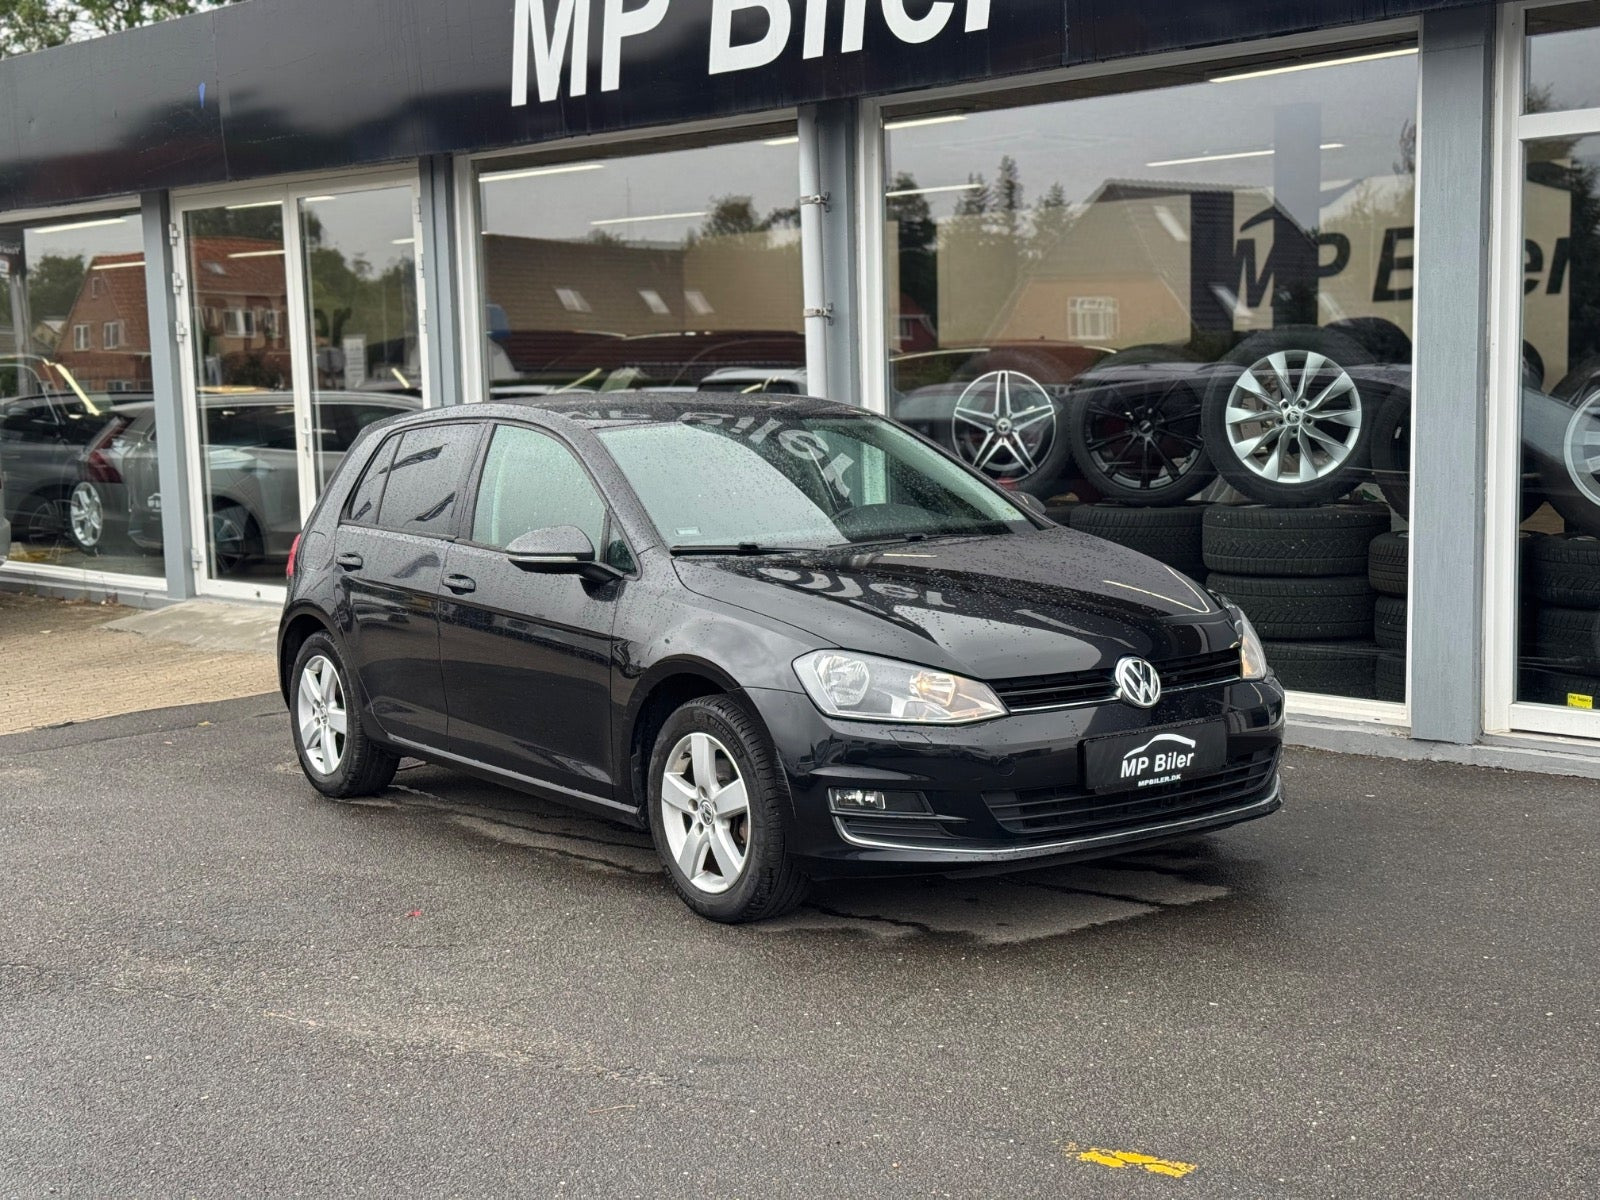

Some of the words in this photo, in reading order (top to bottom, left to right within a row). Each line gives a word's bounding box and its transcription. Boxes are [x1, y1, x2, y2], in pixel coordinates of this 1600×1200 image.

[511, 0, 669, 106] MP
[1120, 757, 1149, 778] MP
[1154, 751, 1195, 773] Biler
[1137, 773, 1182, 787] MPBILER.DK
